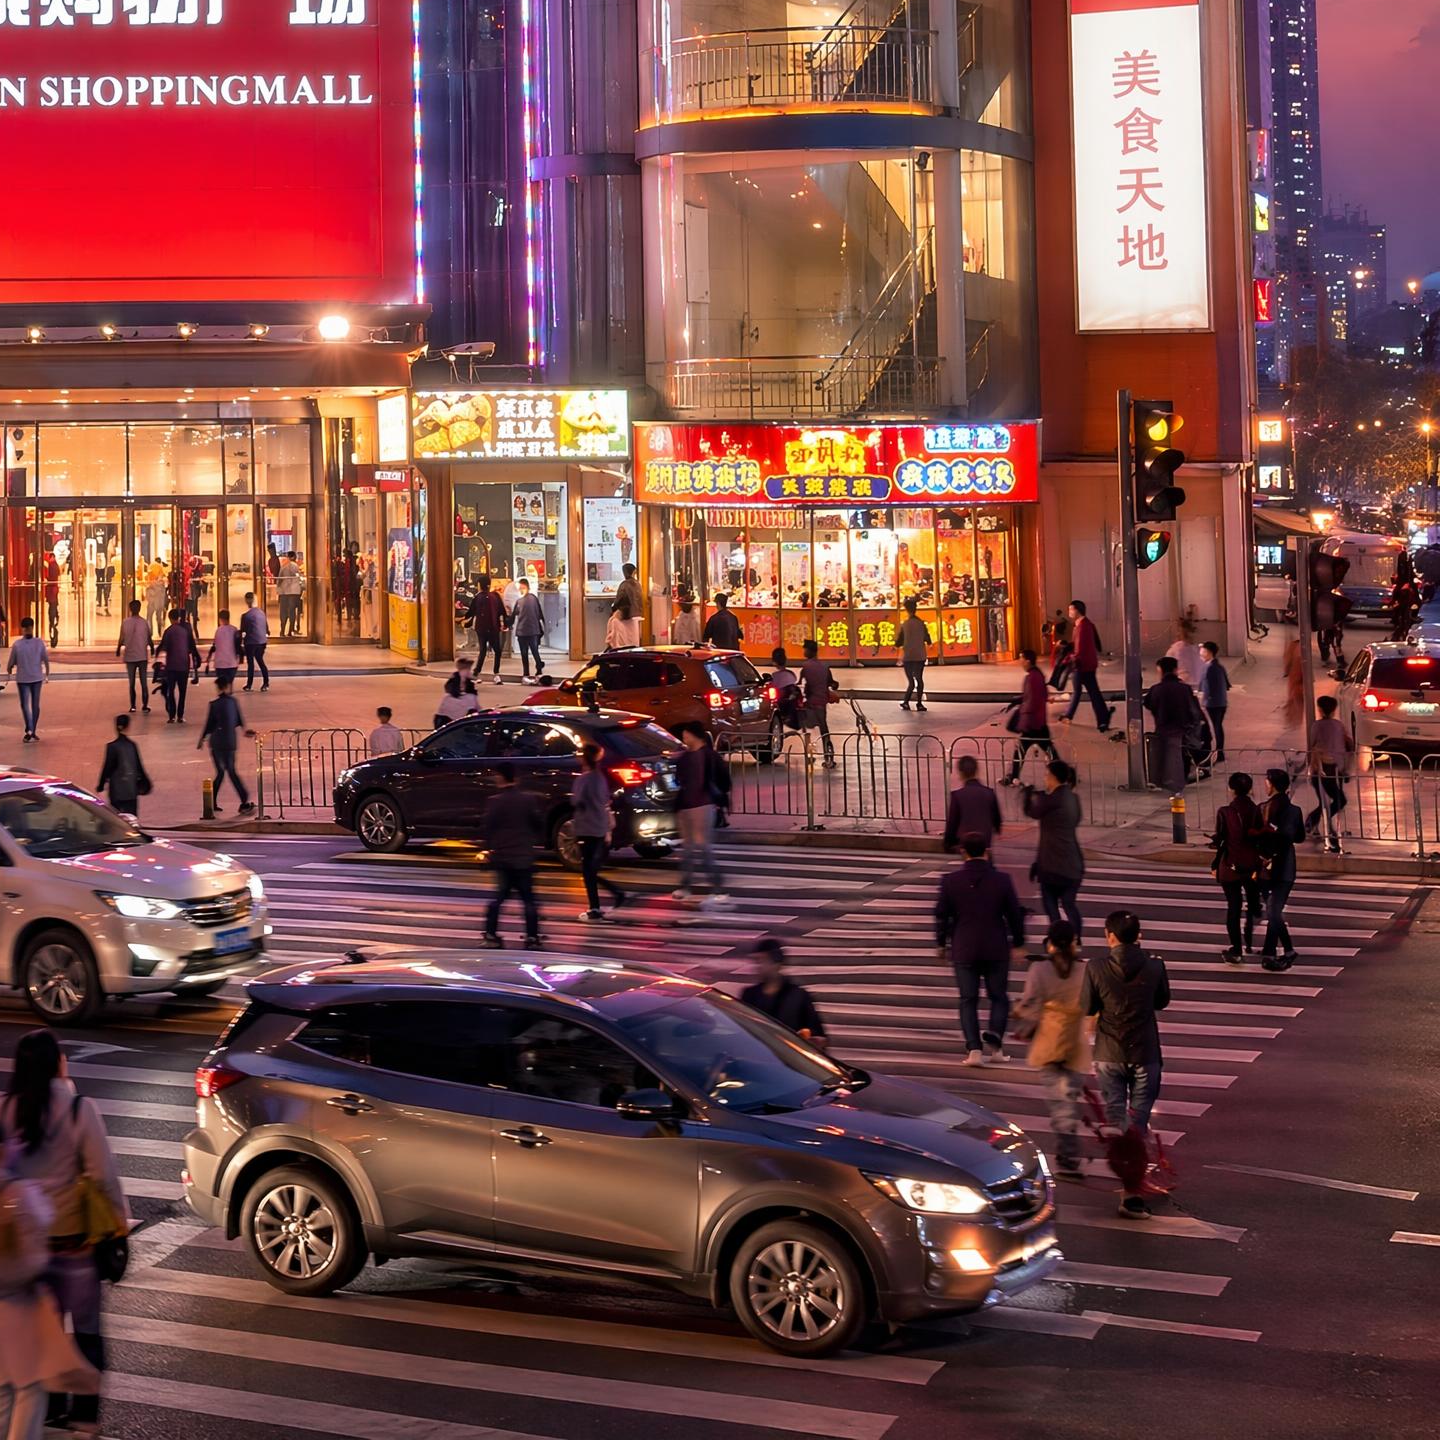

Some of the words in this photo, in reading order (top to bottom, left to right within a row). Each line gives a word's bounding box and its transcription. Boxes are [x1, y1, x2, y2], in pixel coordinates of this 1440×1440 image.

[39, 74, 374, 107] SHOPPINGMALL
[1112, 49, 1168, 271] 美食天地
